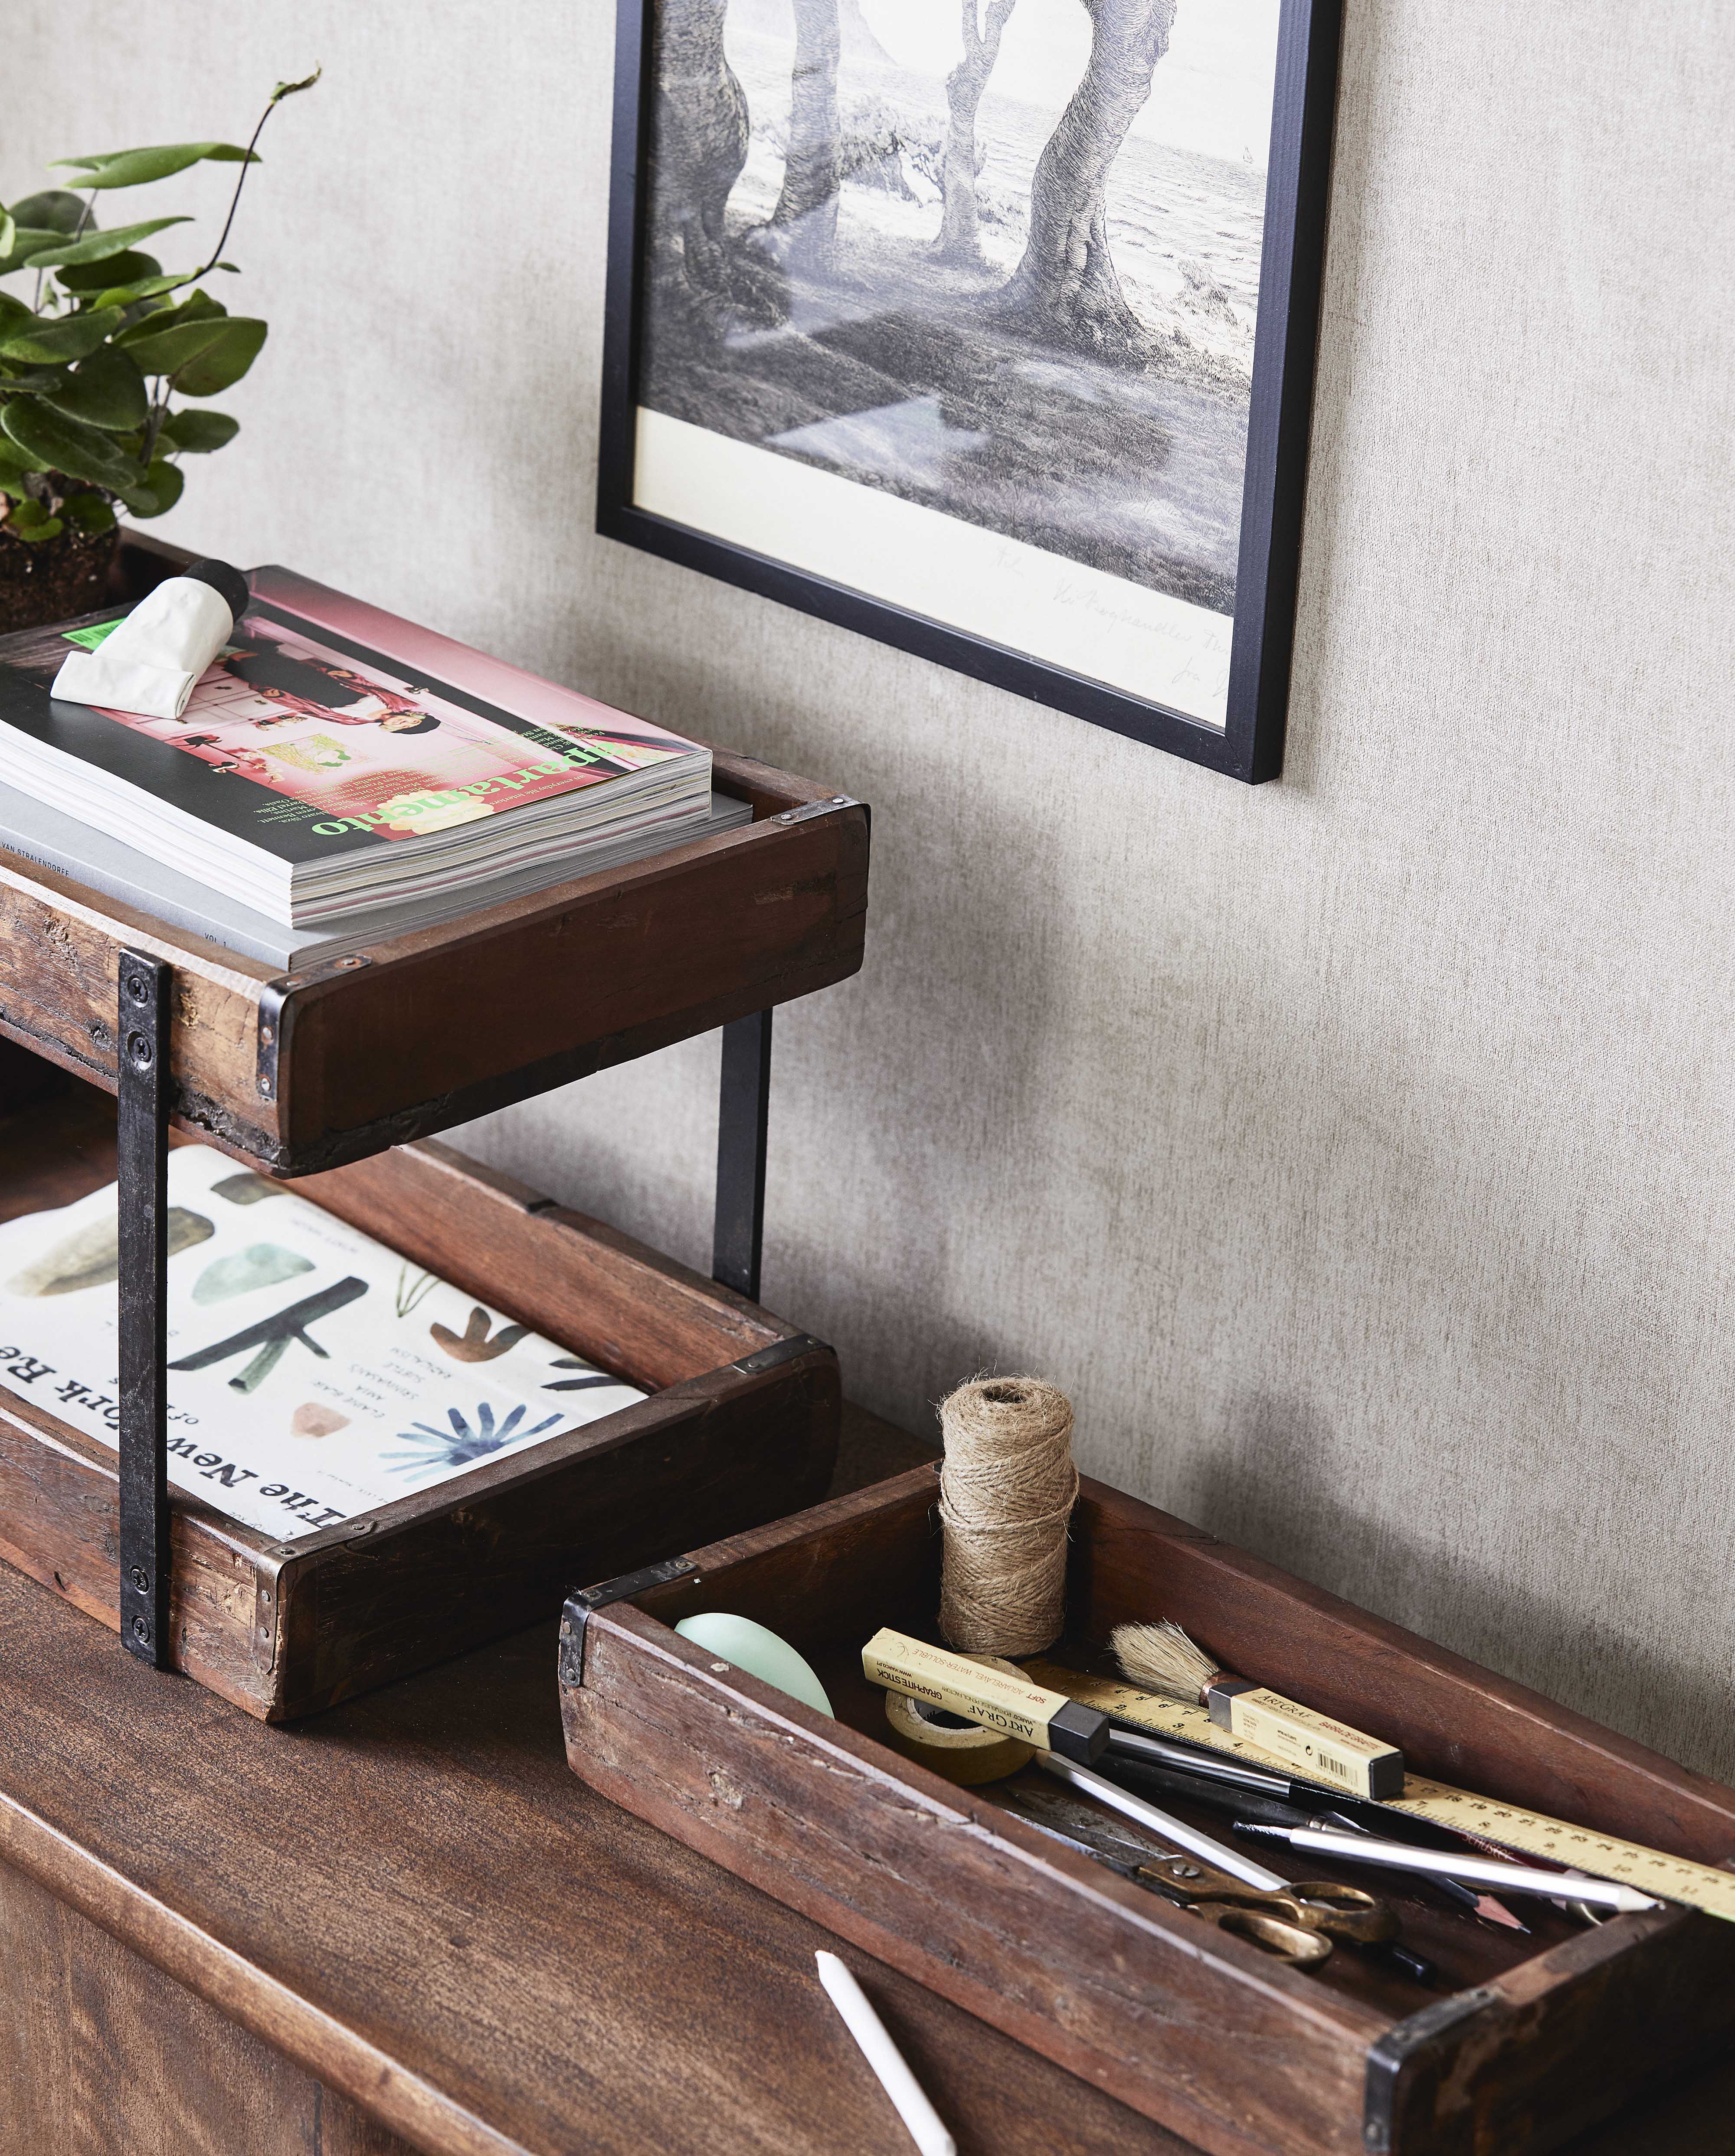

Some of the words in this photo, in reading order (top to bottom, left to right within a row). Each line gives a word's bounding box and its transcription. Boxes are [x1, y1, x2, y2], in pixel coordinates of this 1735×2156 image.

[310, 740, 627, 835] apartamento
[354, 781, 383, 790] Frame
[393, 782, 421, 791] Marco
[537, 778, 574, 791] everyday
[307, 789, 354, 801] remembers
[488, 793, 526, 805] interiors
[271, 805, 307, 814] Martins,
[277, 800, 307, 808] Darrel
[321, 799, 354, 808] Sydney
[257, 813, 296, 823] Bennett,
[2, 842, 15, 853] VAN
[17, 849, 69, 876] STRALENDORFF
[54, 1380, 119, 1430] ork
[167, 1412, 199, 1425] of
[165, 1438, 259, 1488] New
[255, 1482, 347, 1529] The
[911, 1647, 973, 1676] WATER-SOLUBLE
[876, 1660, 912, 1678] WWW.VIARCO.PT
[941, 1685, 962, 1698] FACTORY
[1025, 1692, 1047, 1704] SOFT
